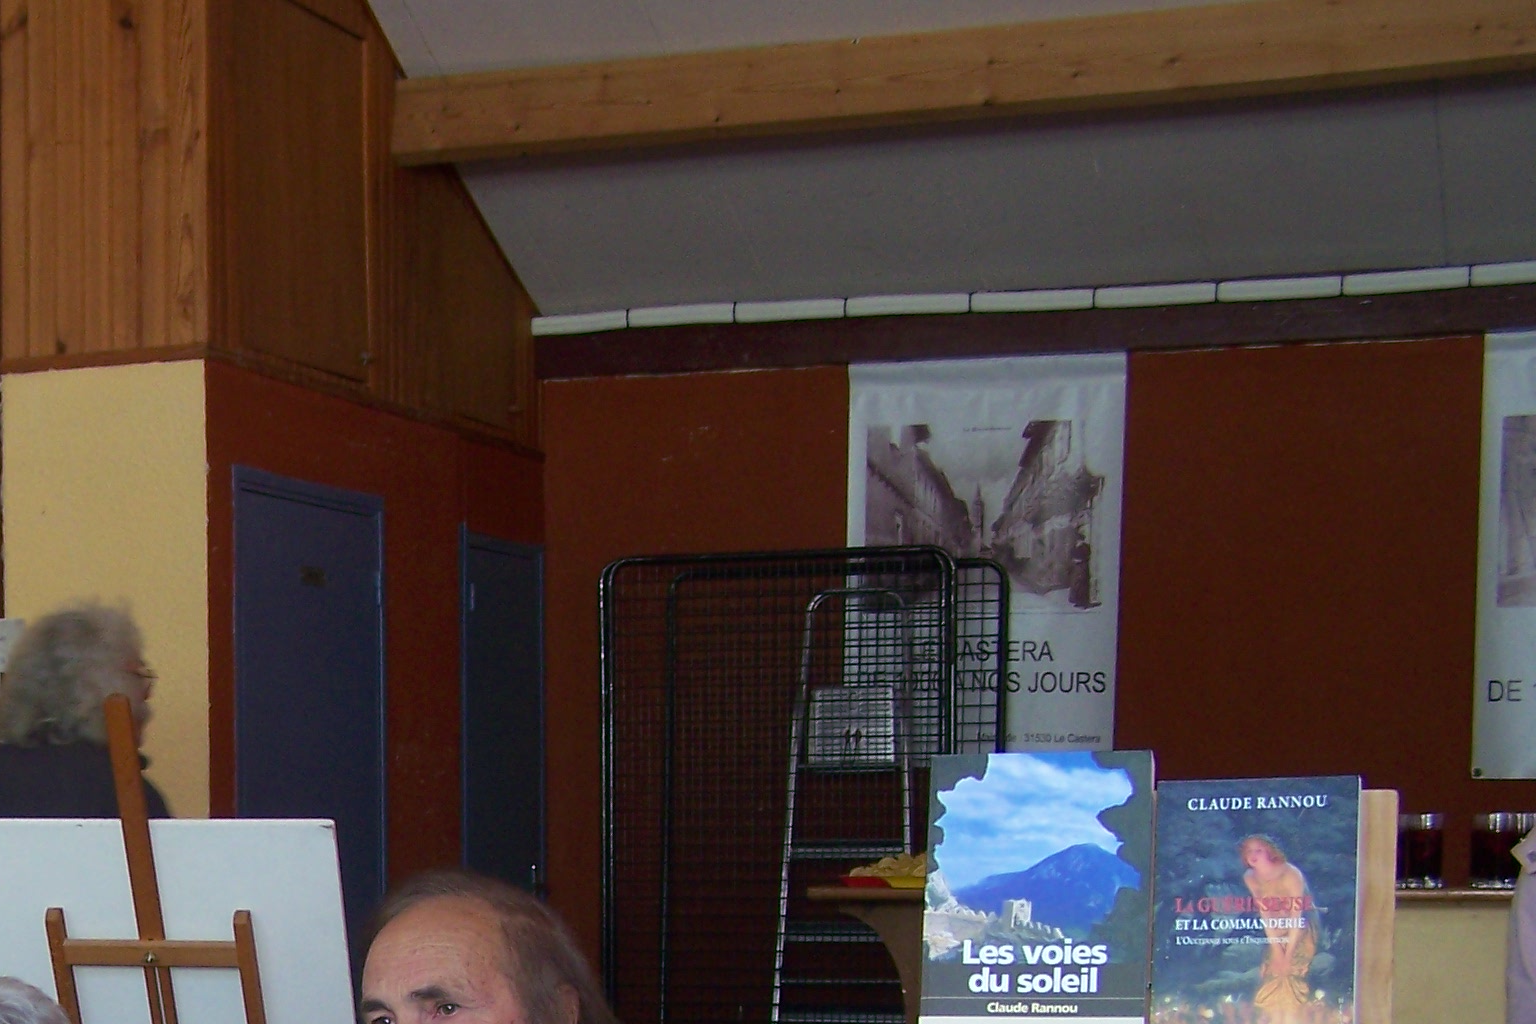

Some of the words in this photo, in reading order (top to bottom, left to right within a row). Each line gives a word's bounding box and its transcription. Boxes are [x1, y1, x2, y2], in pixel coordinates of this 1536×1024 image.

[944, 640, 1054, 662] ASERA
[1028, 670, 1106, 694] JOURS
[1488, 680, 1522, 702] DE
[1187, 797, 1252, 811] CLAUDE
[1256, 795, 1327, 809] RANNOU
[1175, 919, 1188, 930] ET
[1192, 919, 1208, 930] LA
[1210, 917, 1306, 930] COMMANDERIE
[962, 939, 1014, 965] Les
[1022, 938, 1108, 965] voies
[968, 967, 1009, 993] du
[1017, 967, 1098, 993] soleil
[986, 1002, 1028, 1014] Claude
[1031, 1002, 1078, 1014] Rannou
